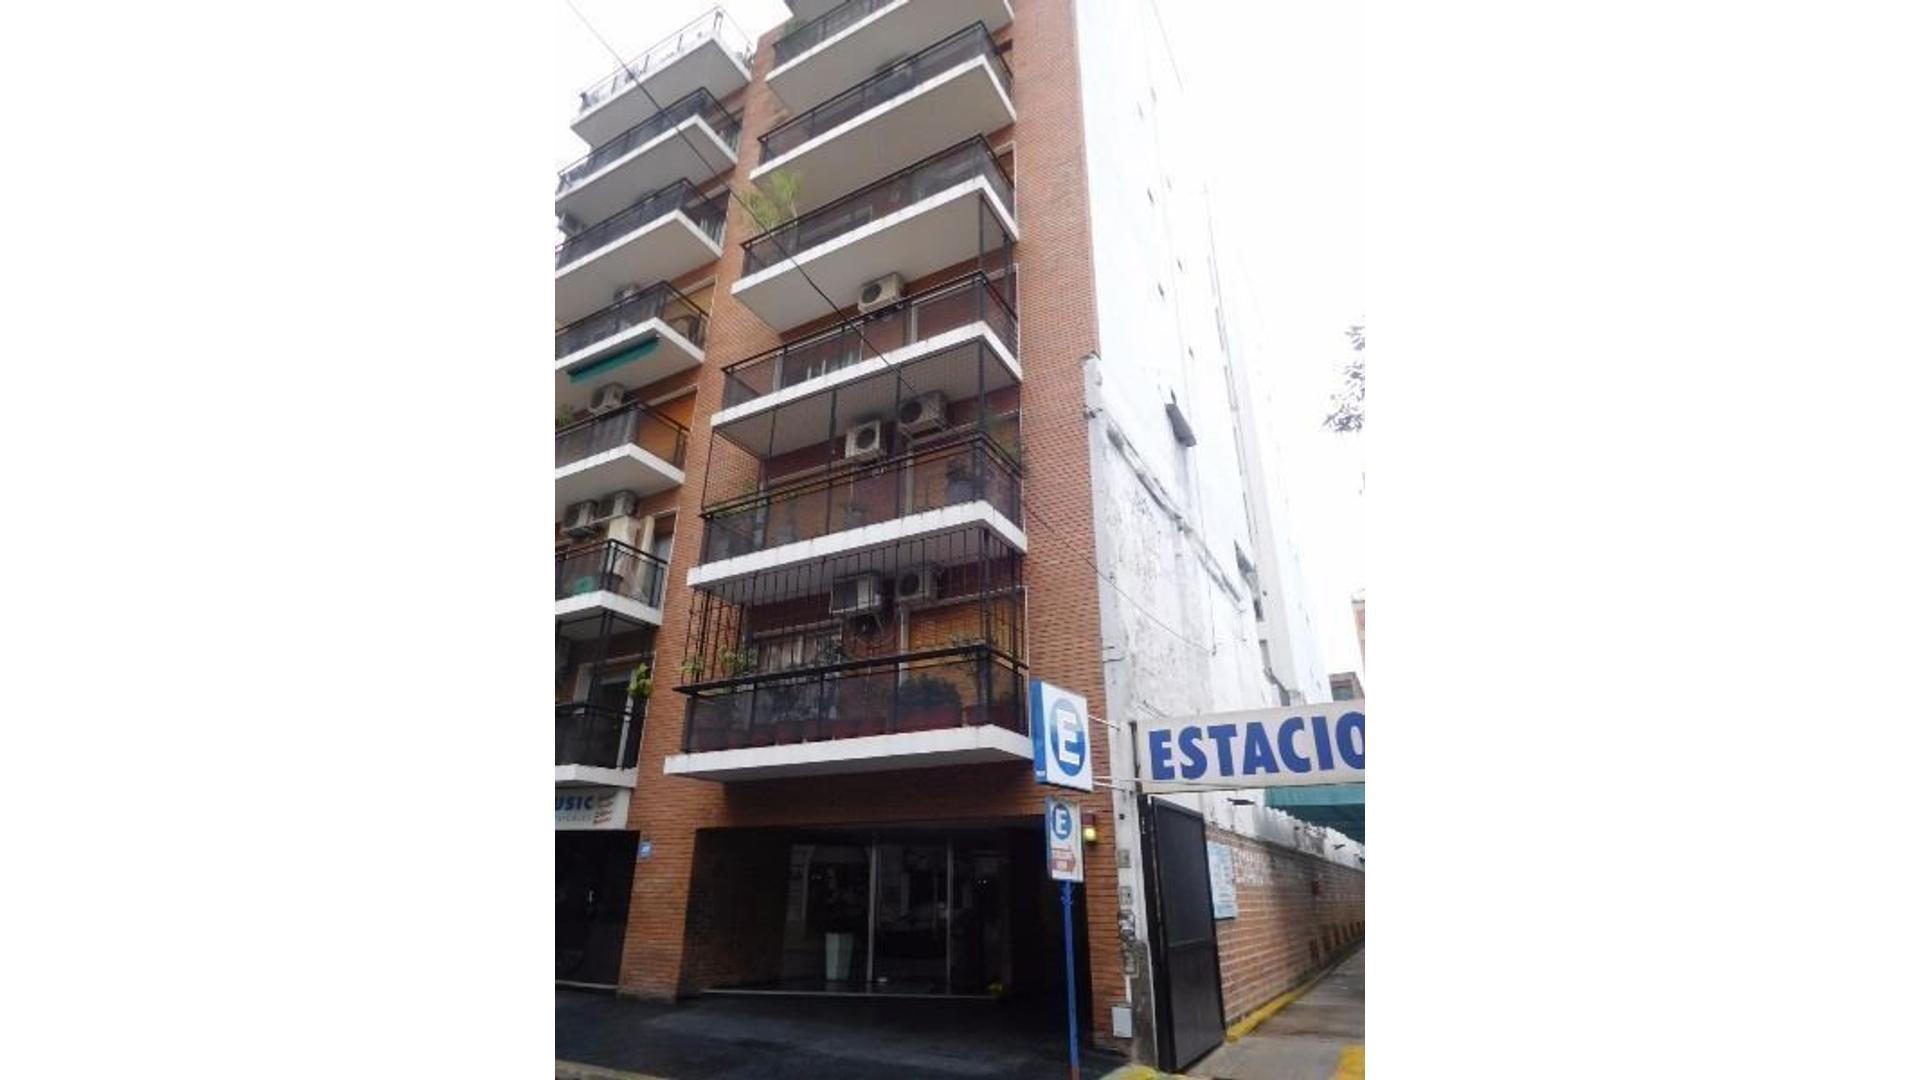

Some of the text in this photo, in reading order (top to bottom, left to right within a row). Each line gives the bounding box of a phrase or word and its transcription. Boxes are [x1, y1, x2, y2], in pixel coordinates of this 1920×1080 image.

[1056, 709, 1080, 765] E
[1149, 712, 1365, 780] ESTACIO
[1055, 808, 1067, 835] E
